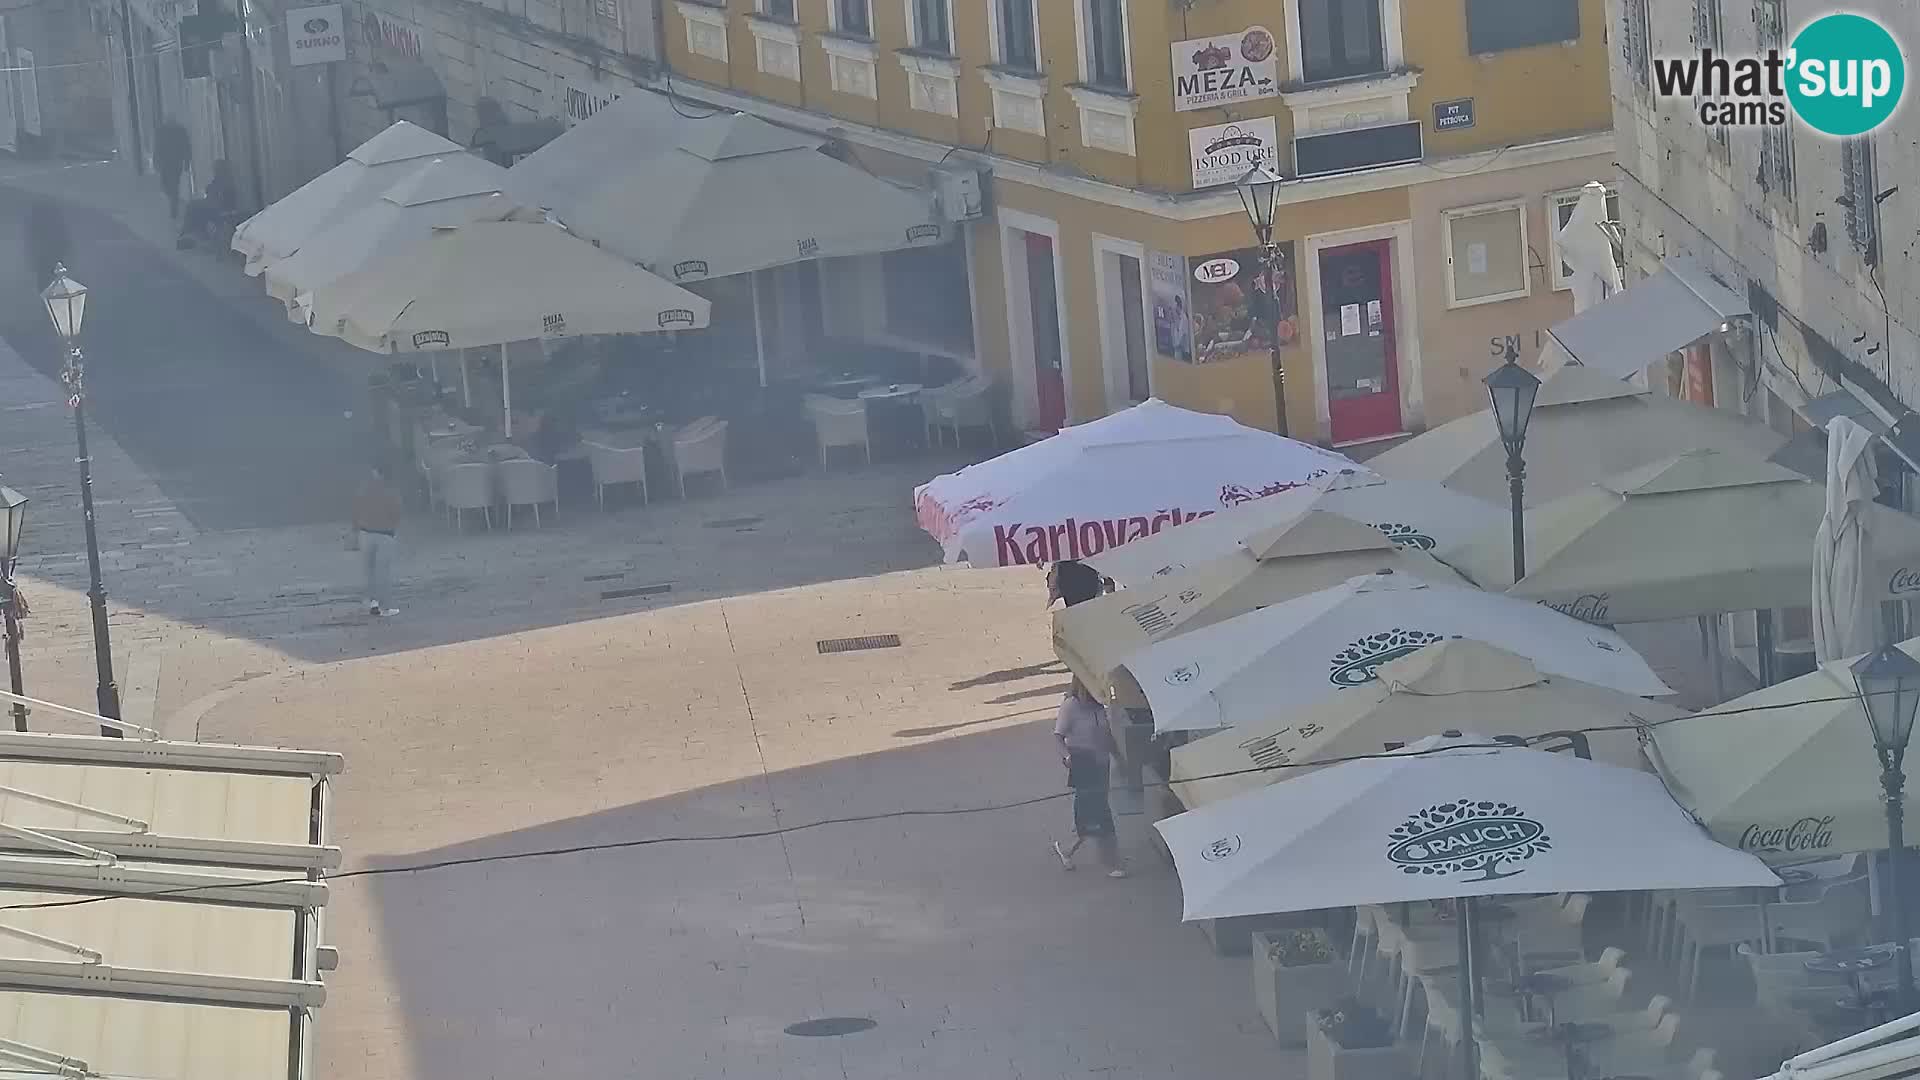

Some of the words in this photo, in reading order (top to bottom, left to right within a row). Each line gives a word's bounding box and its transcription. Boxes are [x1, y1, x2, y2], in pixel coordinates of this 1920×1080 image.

[296, 35, 341, 49] SUKNO
[1177, 66, 1256, 97] MEZA
[1186, 91, 1219, 105] PIZZERIA
[1227, 88, 1248, 98] GRILL
[1196, 152, 1241, 170] ISPOD
[1246, 146, 1275, 162] URE
[993, 507, 1216, 567] Karlovač
[1427, 823, 1526, 855] RAUCH
